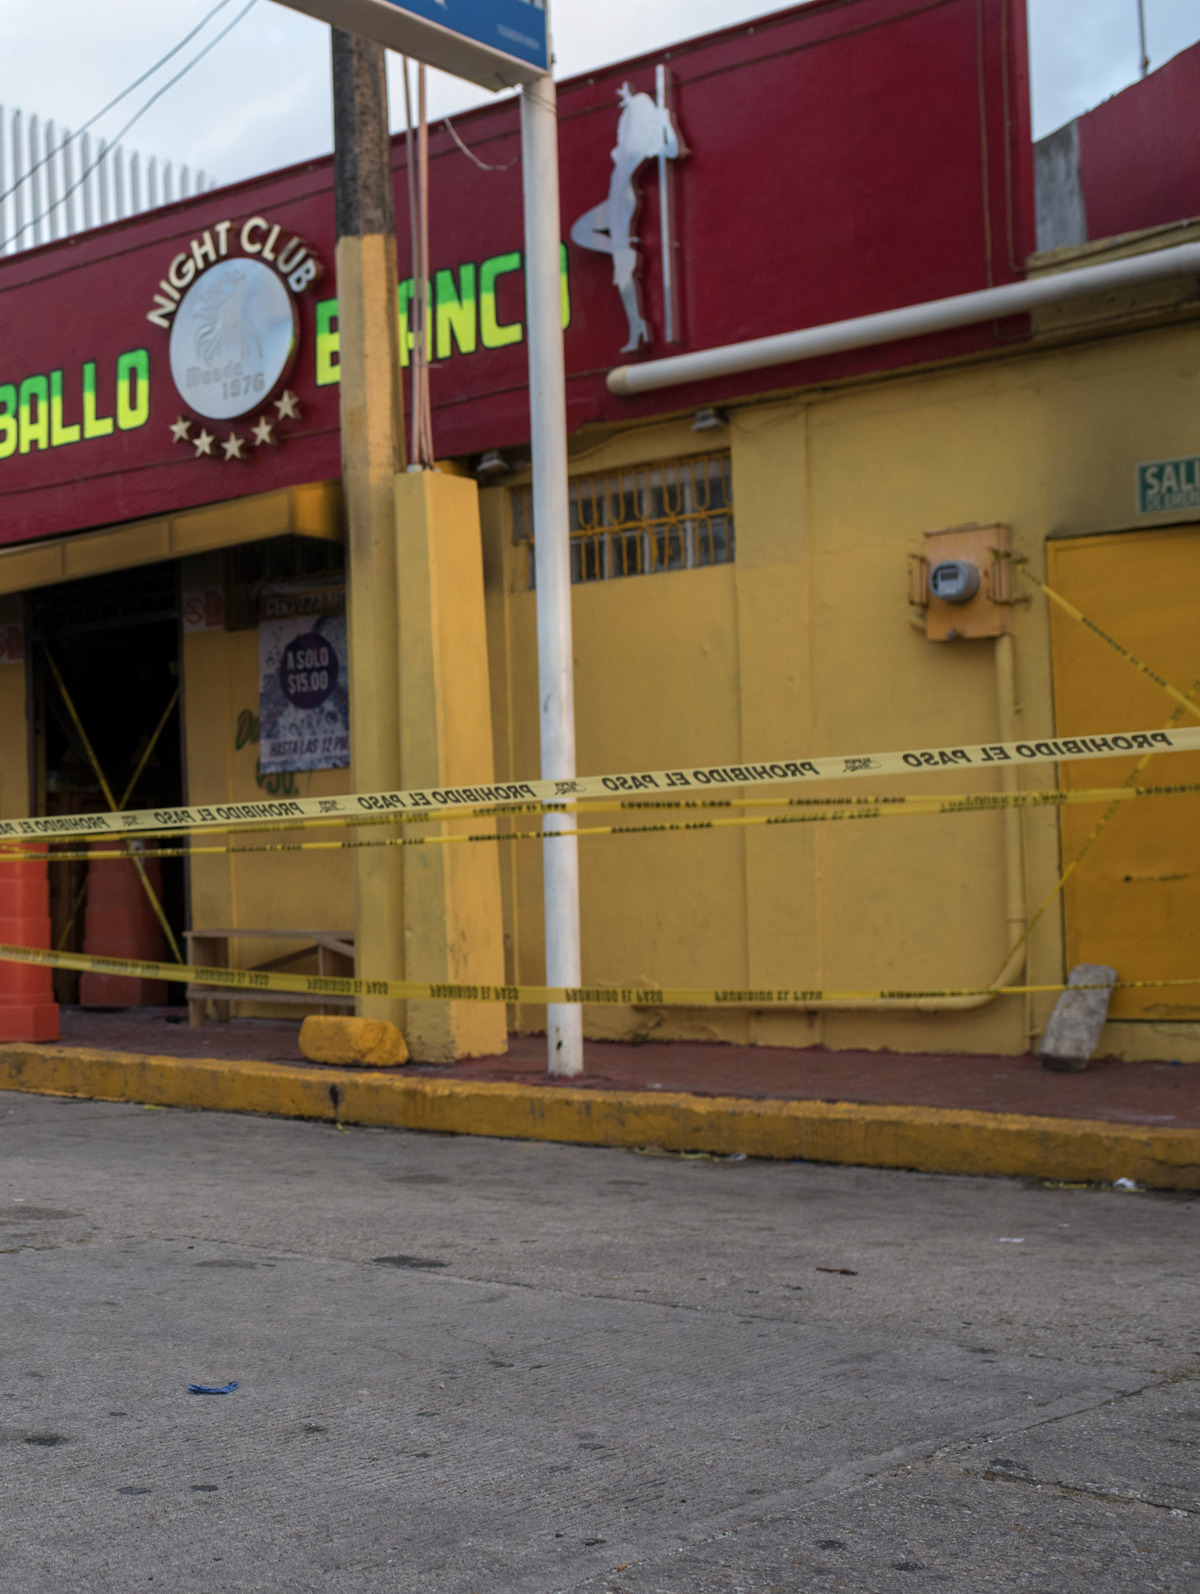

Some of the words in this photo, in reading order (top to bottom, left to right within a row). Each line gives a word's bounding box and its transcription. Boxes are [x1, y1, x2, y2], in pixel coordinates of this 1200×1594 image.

[146, 219, 232, 329] NIGHT
[240, 216, 319, 293] CLUB
[314, 241, 570, 387] BANC
[222, 373, 265, 400] 1976
[287, 651, 295, 671] A
[296, 646, 329, 670] SOLO
[287, 670, 329, 695] $15.00
[270, 739, 298, 757] HASTA
[300, 737, 318, 755] LAS
[322, 736, 333, 753] 12
